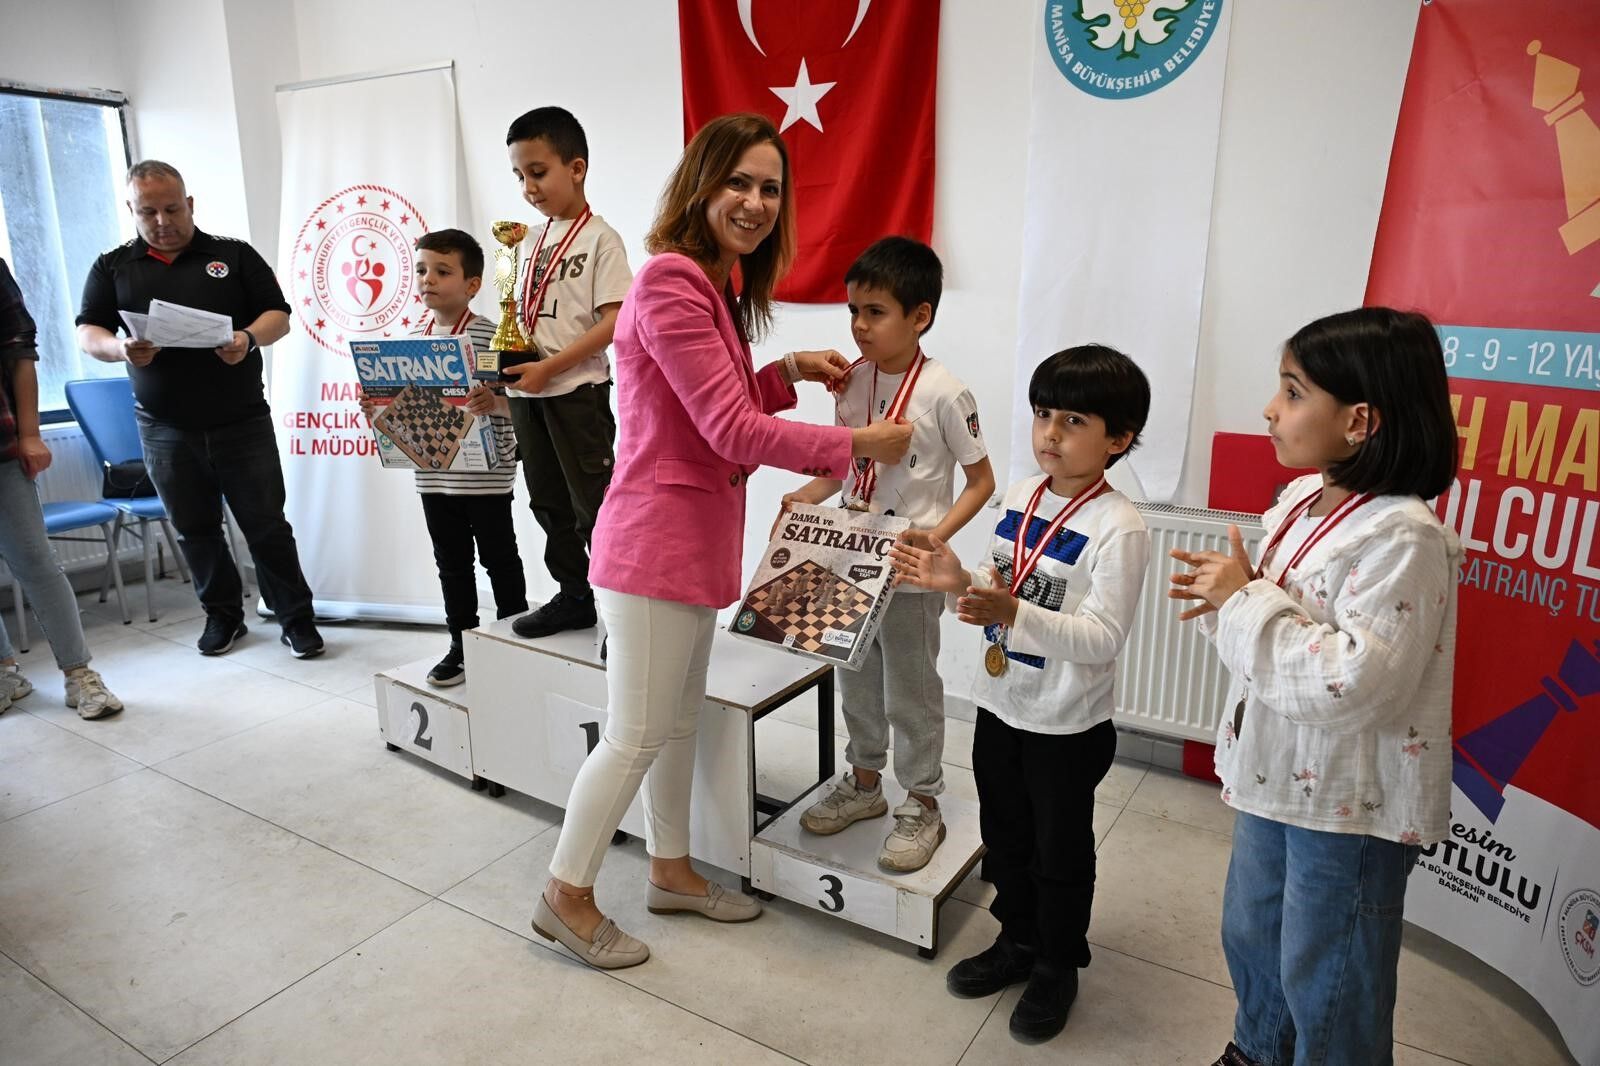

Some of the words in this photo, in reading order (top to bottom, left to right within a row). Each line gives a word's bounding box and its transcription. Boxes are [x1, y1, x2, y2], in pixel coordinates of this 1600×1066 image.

[1051, 4, 1074, 64] MANİSA
[1072, 60, 1162, 93] BÜYÜKŞEHİR
[1163, 0, 1215, 73] BELEDİYE
[349, 217, 390, 232] GENÇLİK
[389, 229, 399, 244] VE
[317, 224, 349, 290] CUMHURİYETİ
[397, 243, 409, 271] SPOR
[320, 292, 351, 326] TÜRKİYE
[374, 276, 409, 325] BAKANLIĞI
[1482, 339, 1500, 371] 9
[1528, 341, 1556, 376] 12
[442, 388, 466, 396] CHESS
[284, 409, 360, 433] GENÇLİK
[290, 434, 306, 455] İL
[790, 512, 820, 524] DAMA
[782, 523, 896, 561] SATRANÇ
[870, 568, 896, 622] SATRAN
[410, 702, 432, 751] 2
[579, 721, 600, 756] 1
[1450, 811, 1517, 862] esim
[818, 874, 845, 912] 3
[1428, 864, 1486, 898] BÜYÜKŞEHİR
[1487, 892, 1531, 923] BELEDİYE
[1438, 877, 1479, 903] BAŞKANI
